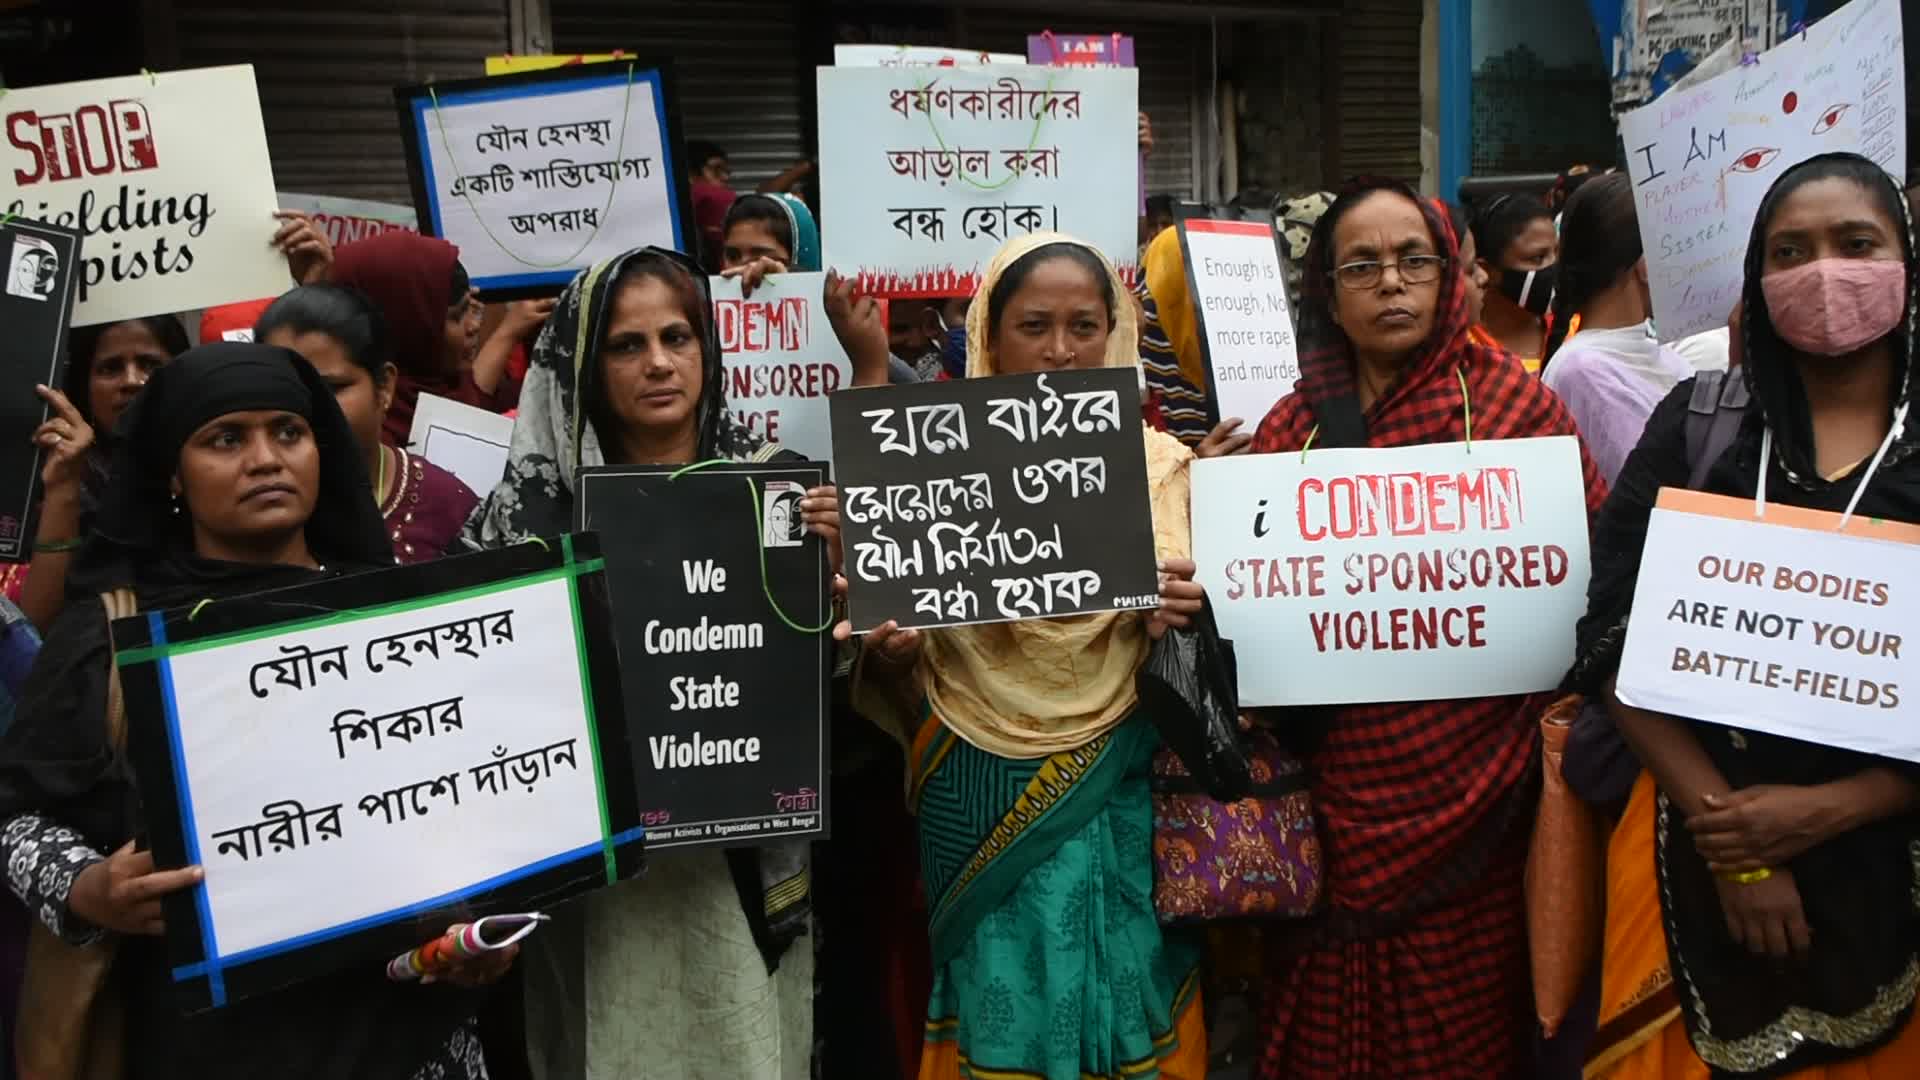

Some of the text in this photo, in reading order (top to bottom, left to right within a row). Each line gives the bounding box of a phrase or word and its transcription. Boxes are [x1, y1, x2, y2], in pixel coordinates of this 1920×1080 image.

[888, 77, 1080, 120] ধর্ষণকারীদের
[6, 98, 158, 186] STOP
[476, 119, 611, 154] যৌন হেনস্থা
[1635, 126, 1726, 186] I AM
[450, 157, 651, 198] একটি শাস্তিযোগ্য
[886, 145, 1060, 187] আড়াল করা
[508, 207, 599, 236] অপরাধ
[888, 207, 946, 242] বন্ধ
[1659, 219, 1729, 260] SISTER
[79, 236, 194, 302] pists
[1204, 257, 1275, 282] Enough is
[1206, 293, 1287, 316] enough, No
[1217, 329, 1291, 351] more rape
[1218, 361, 1247, 382] and
[861, 373, 1121, 457] ঘরে বাইরে
[844, 456, 1106, 523] মেয়েদের ওপর
[1253, 467, 1524, 541] i CONDEMN
[854, 517, 1064, 582] যৌন নির্যাতন
[682, 559, 727, 594] We
[1225, 545, 1569, 600] STATE SPONSORED
[1697, 555, 1890, 607] OUR BODIES
[912, 570, 1101, 621] বন্ধ হোক
[644, 616, 763, 655] Condemn
[1309, 605, 1487, 652] VIOLENCE
[1667, 599, 1903, 660] ARE NOT YOUR
[248, 609, 515, 698] যৌন হেনস্থার
[669, 675, 740, 711] State
[1671, 647, 1900, 709] BATTLE-FIELDS
[330, 696, 464, 759] শিকার
[648, 731, 761, 770] Violence
[212, 744, 577, 862] নারীর পাশে দাঁড়ান
[645, 830, 672, 841] Women
[714, 821, 761, 836] Organisations
[772, 816, 790, 828] West
[792, 814, 815, 829] Bengal
